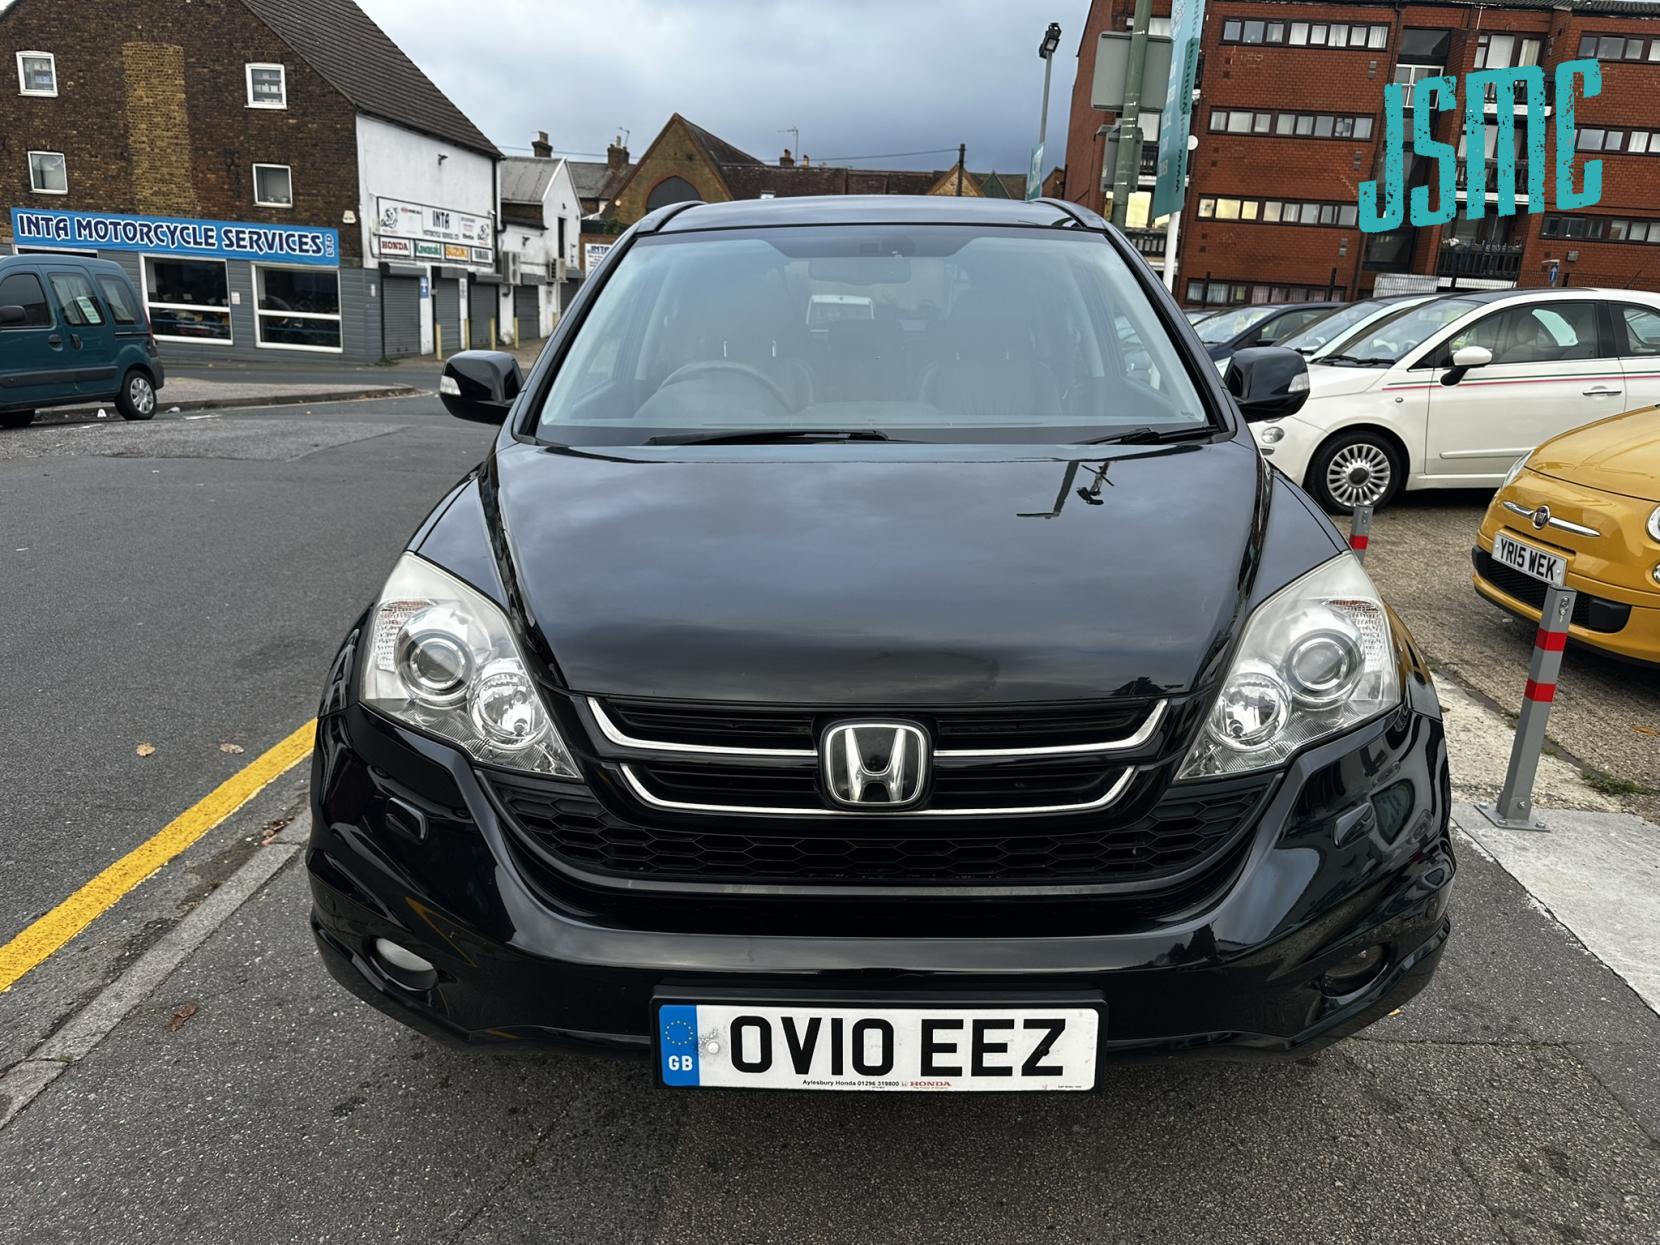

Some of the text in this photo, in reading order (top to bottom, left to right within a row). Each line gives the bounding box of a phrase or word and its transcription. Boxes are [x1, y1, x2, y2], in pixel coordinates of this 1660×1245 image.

[18, 213, 69, 241] INTA
[76, 218, 217, 248] MOTORCYCLE
[223, 227, 324, 256] SERVICES
[381, 240, 408, 251] HONDA
[1501, 538, 1556, 581] YR15 WEK
[921, 1018, 1066, 1077] EEZ
[668, 1055, 693, 1071] GB
[802, 1079, 834, 1087] Aylesbury
